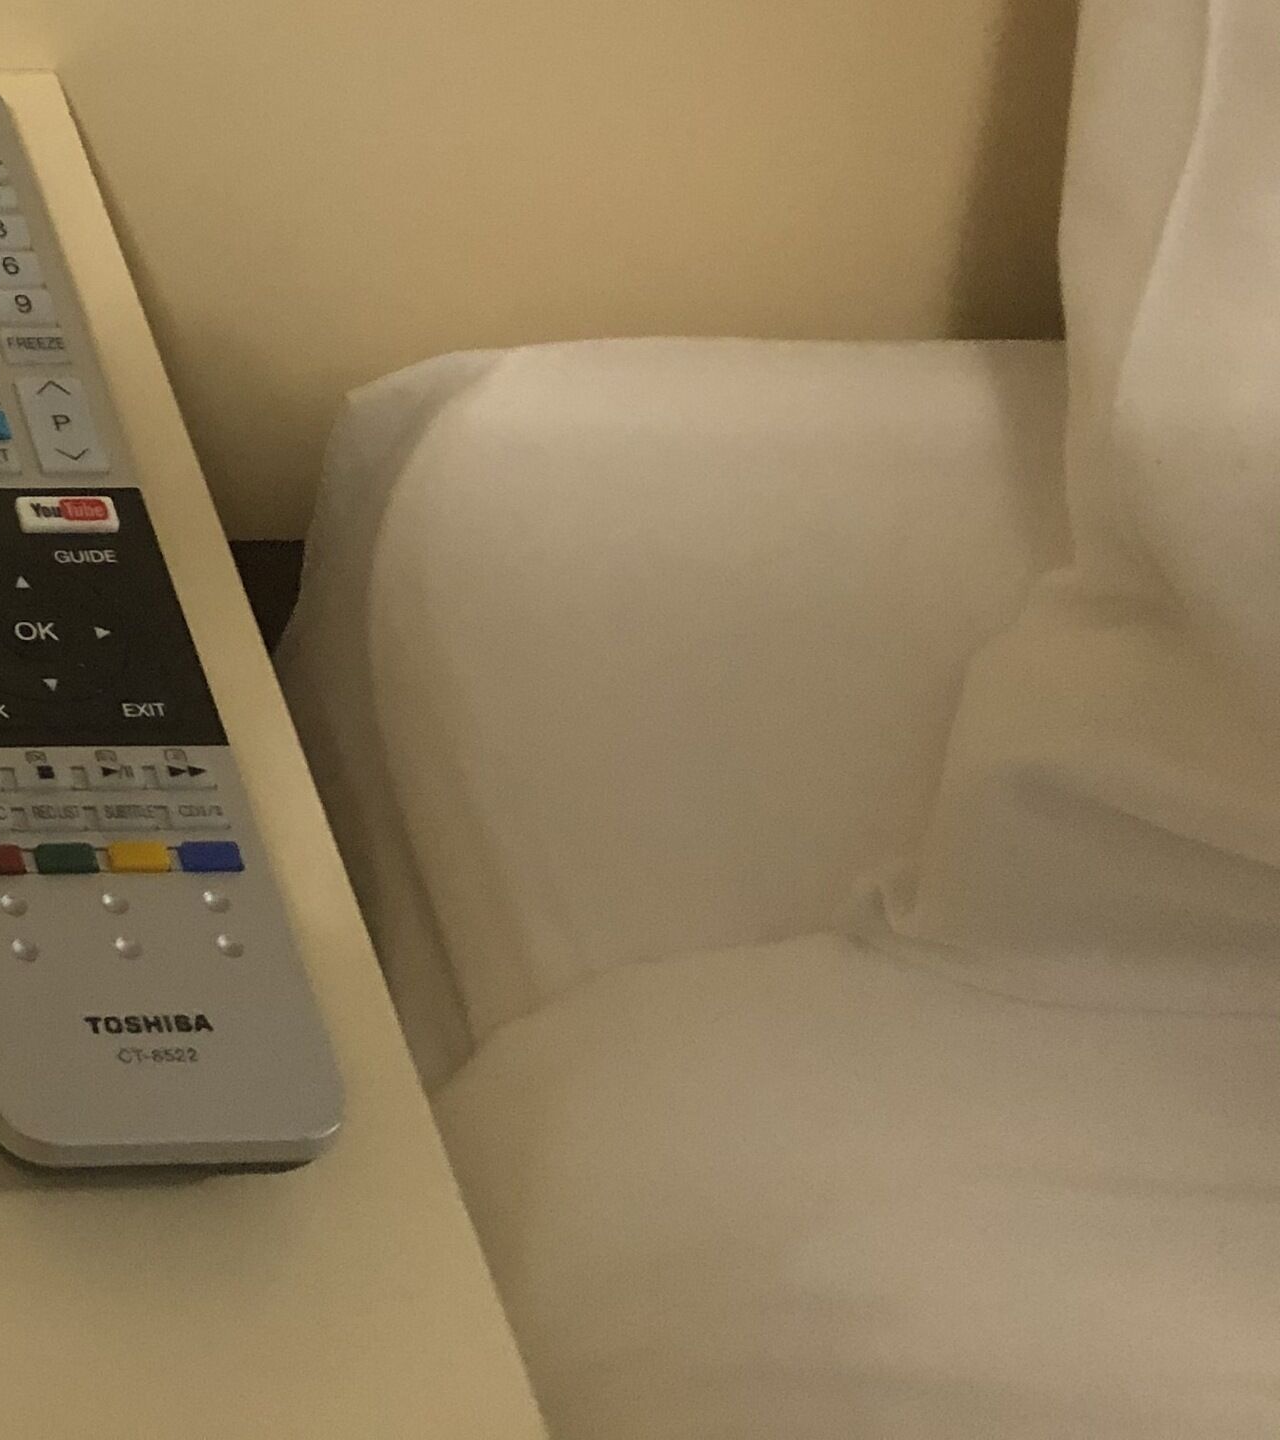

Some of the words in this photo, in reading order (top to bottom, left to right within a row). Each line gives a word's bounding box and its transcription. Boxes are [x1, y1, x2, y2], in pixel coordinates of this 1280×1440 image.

[1, 256, 20, 275] 6
[14, 294, 32, 314] 9
[6, 335, 65, 351] FREEZE
[52, 414, 72, 432] P
[30, 501, 108, 520] YouTube
[53, 549, 118, 564] GUIDE
[13, 621, 60, 642] OK
[122, 702, 166, 718] EXIT
[83, 1013, 214, 1035] TOSHIBA
